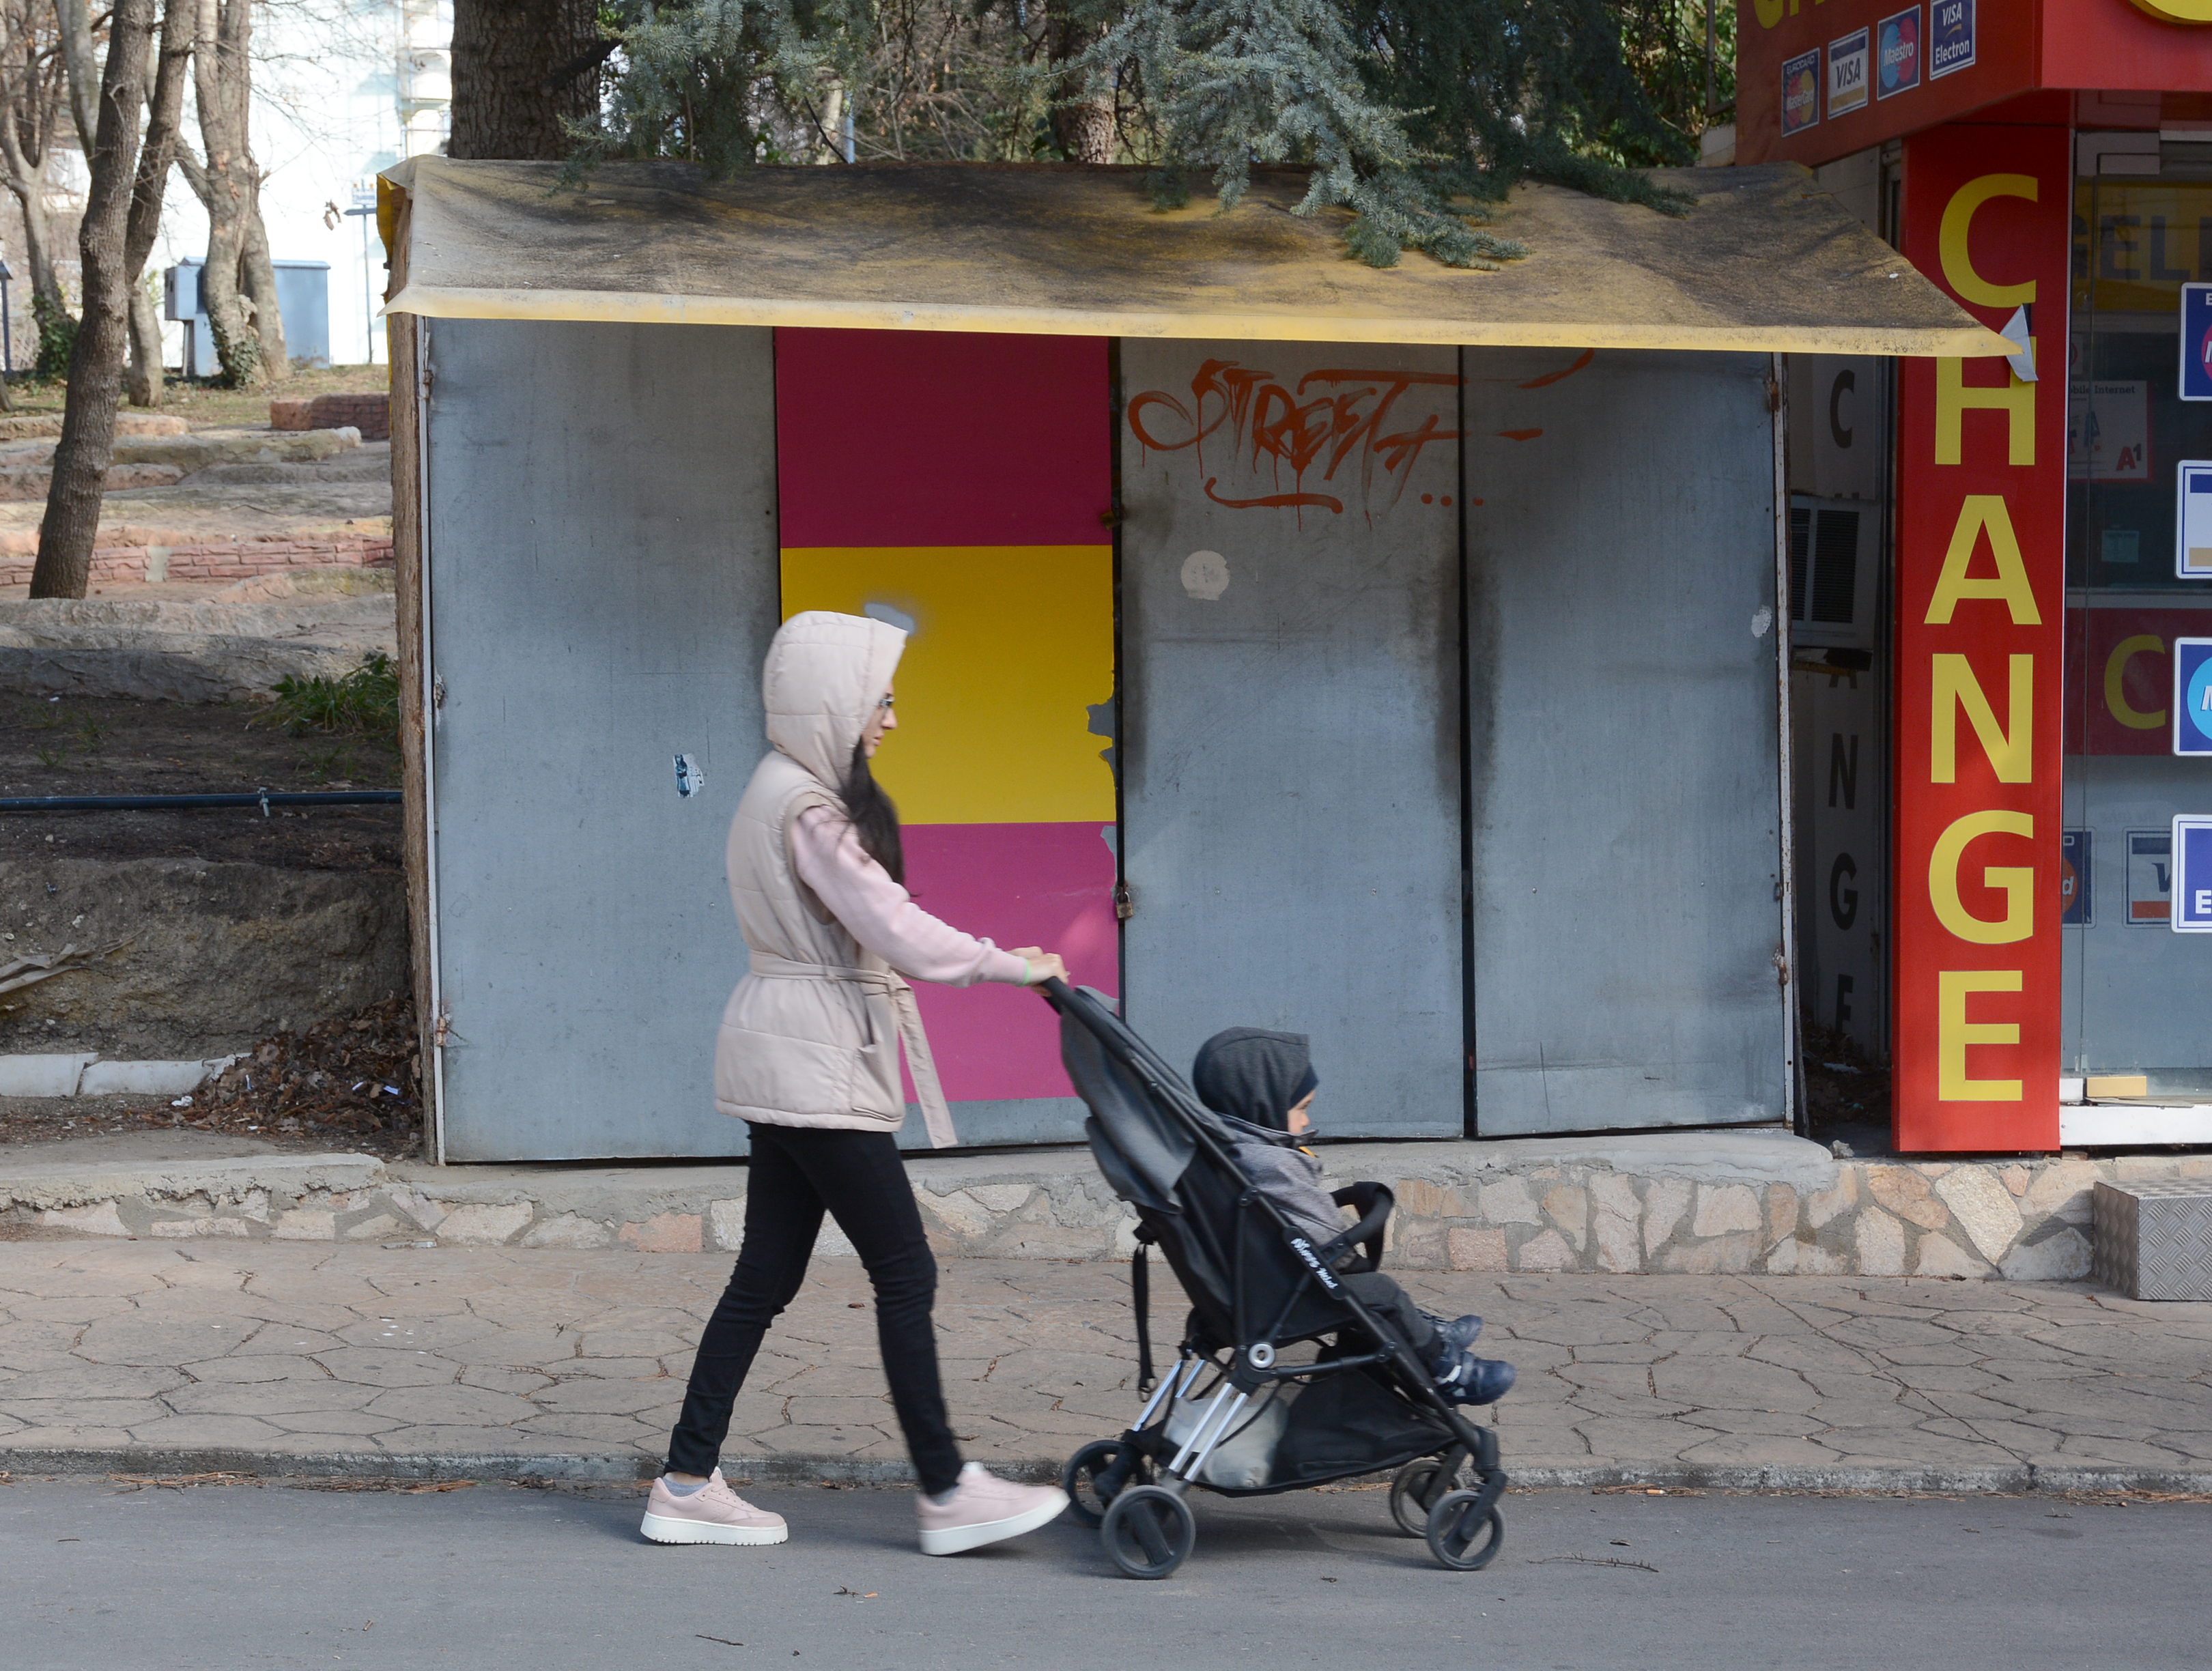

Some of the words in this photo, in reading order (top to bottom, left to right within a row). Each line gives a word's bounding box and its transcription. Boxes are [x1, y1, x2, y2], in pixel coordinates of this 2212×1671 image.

[1942, 1, 1963, 27] VISA
[1883, 42, 1914, 68] Maestro
[1935, 39, 1970, 66] Electron
[1836, 57, 1862, 89] VISA
[1786, 86, 1815, 111] MasterCard
[2095, 385, 2136, 394] Internet
[2116, 444, 2142, 471] A1
[1923, 173, 2043, 1102] CHANGE
